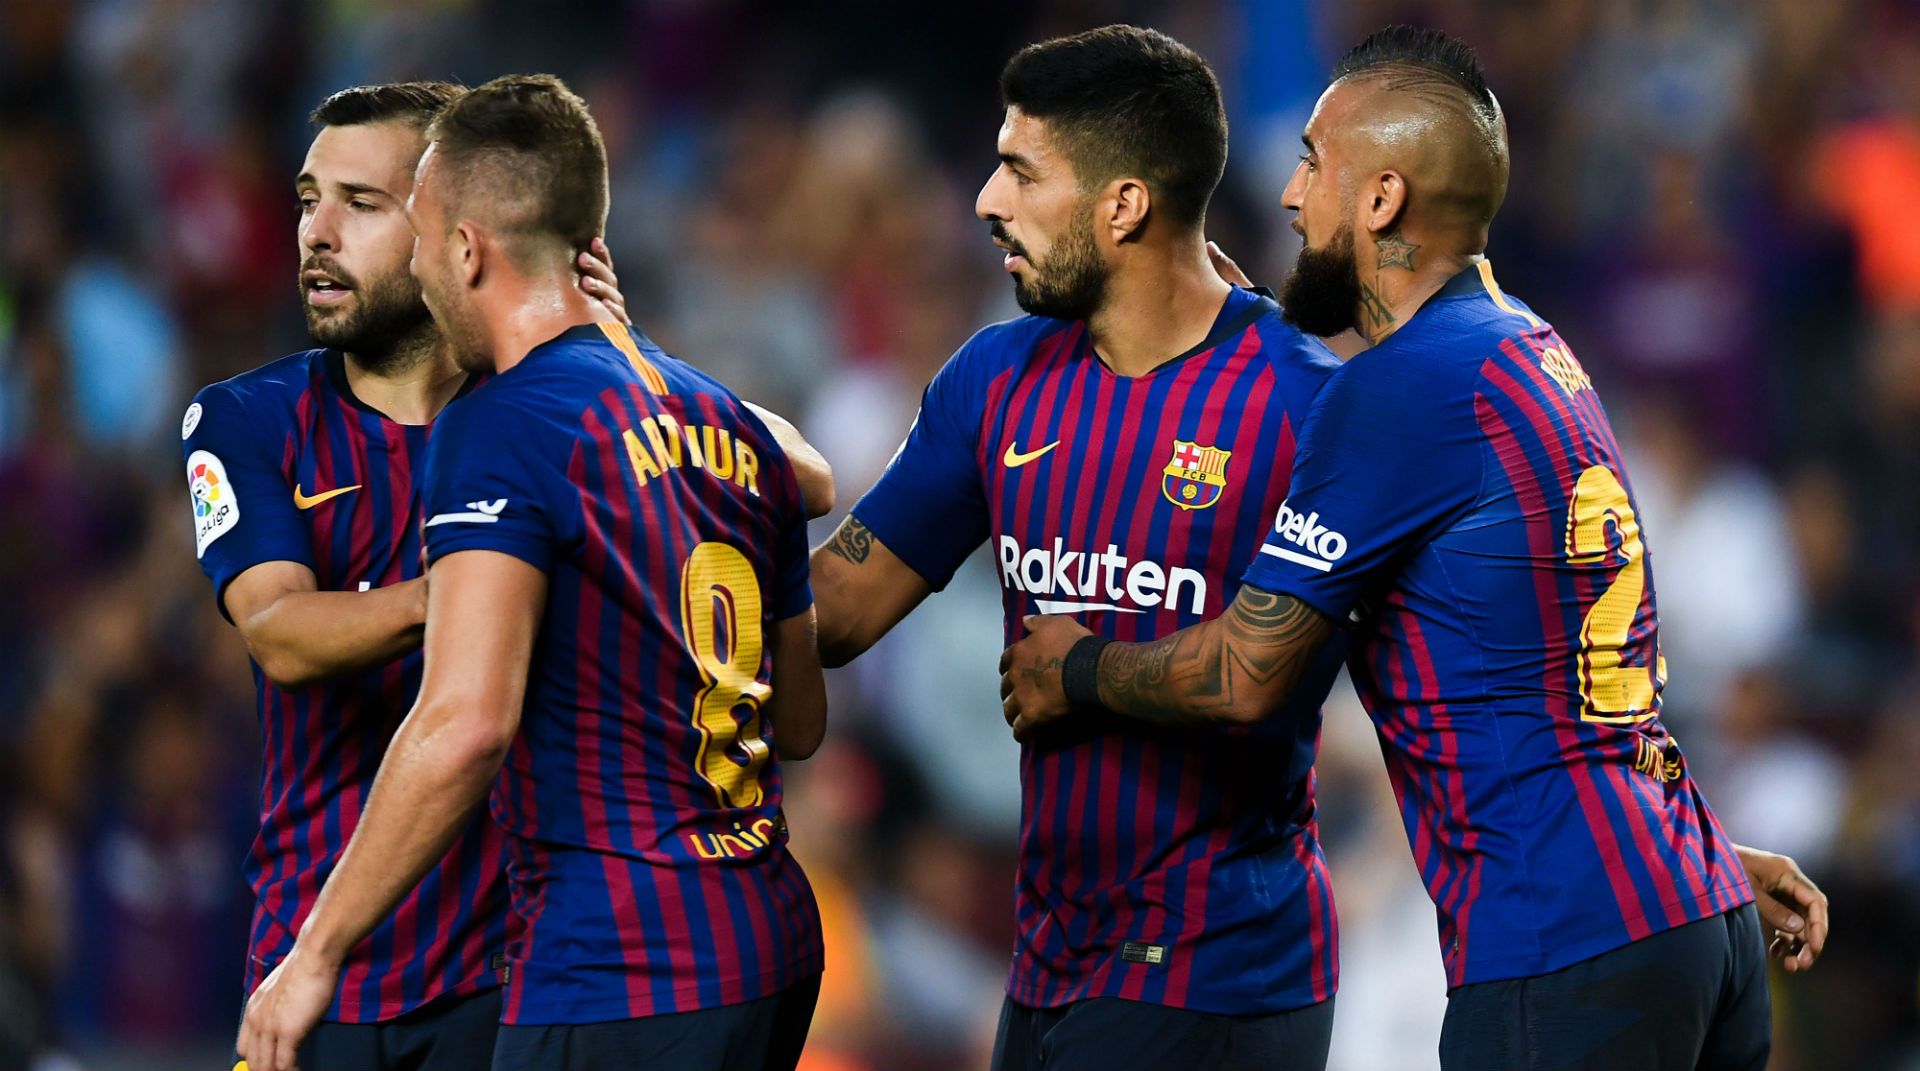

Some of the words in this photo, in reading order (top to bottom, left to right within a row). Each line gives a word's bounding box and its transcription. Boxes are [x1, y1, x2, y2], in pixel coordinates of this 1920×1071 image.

[1182, 469, 1207, 482] FCB
[198, 504, 230, 543] aLiga
[1274, 499, 1348, 561] beko
[1000, 534, 1207, 615] Rakuten
[1565, 464, 1661, 723] 2
[680, 541, 773, 809] 8
